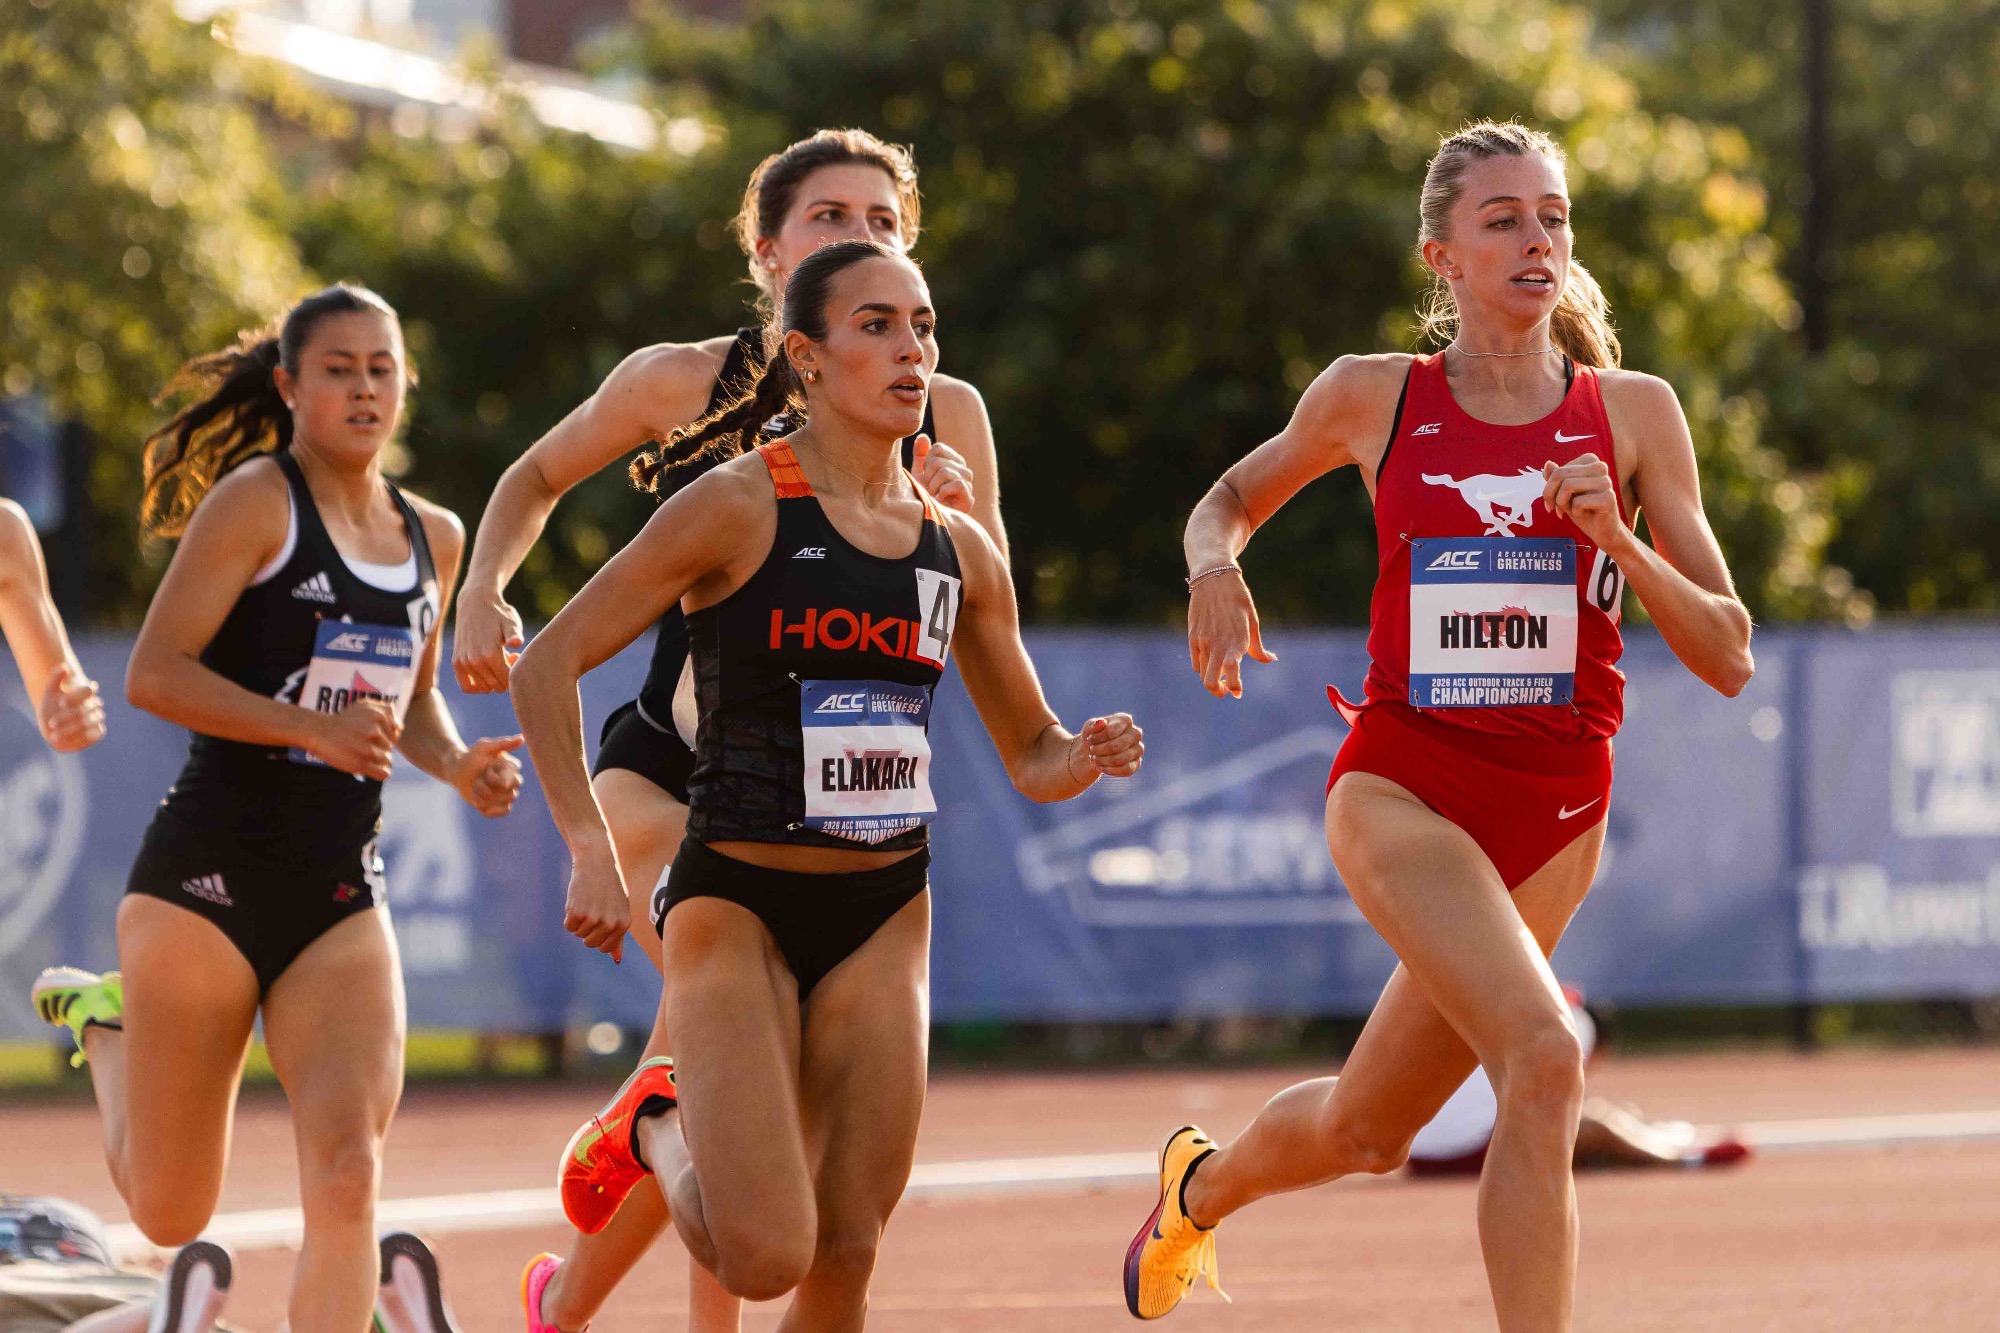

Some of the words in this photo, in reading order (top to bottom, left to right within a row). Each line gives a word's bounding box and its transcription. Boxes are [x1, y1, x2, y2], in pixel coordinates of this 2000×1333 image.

[1411, 423, 1442, 436] ACC
[791, 547, 827, 559] ACC
[1425, 551, 1483, 571] ACC
[1497, 558, 1562, 571] GREATNESS
[927, 580, 950, 660] 4
[1440, 615, 1547, 649] HILTON
[325, 632, 370, 653] ACC
[1432, 678, 1450, 687] 2026
[1453, 678, 1466, 687] ACC
[1469, 678, 1500, 687] OUTDOOR
[1502, 678, 1525, 687] TRACK
[1534, 678, 1553, 686] FIELD
[813, 693, 866, 713] ACC
[1431, 687, 1553, 705] CHAMPIONSHIPS
[871, 700, 922, 714] GREATNESS
[822, 757, 918, 792] ELAKARI
[823, 821, 840, 830] 2026
[841, 821, 853, 830] ACC
[880, 819, 899, 828] TRACK
[905, 817, 921, 826] FIELD
